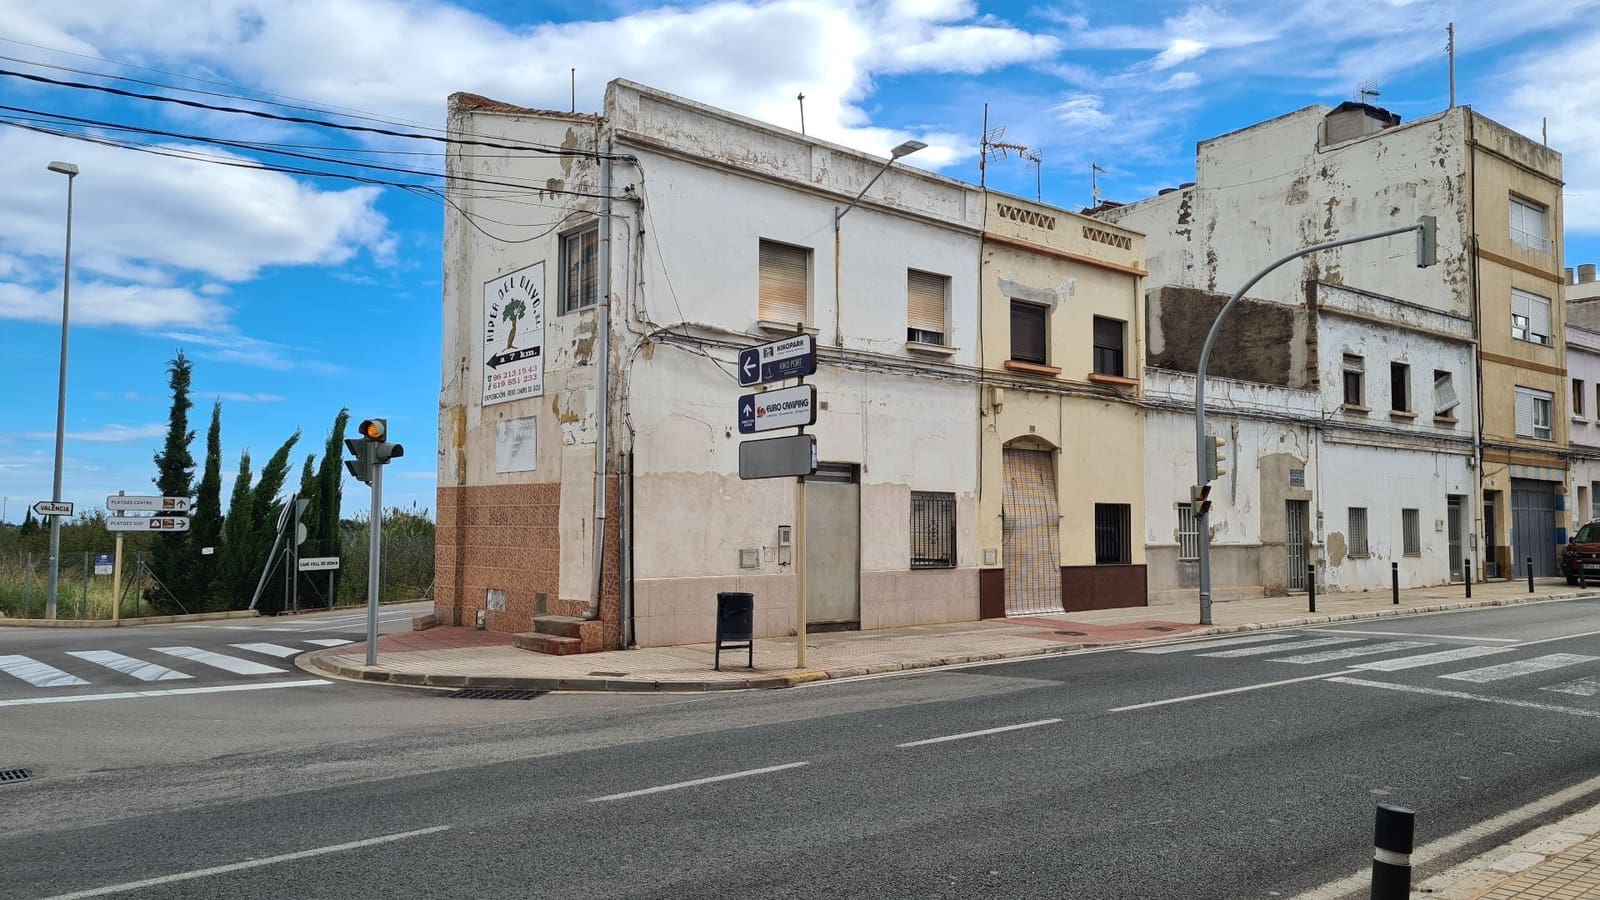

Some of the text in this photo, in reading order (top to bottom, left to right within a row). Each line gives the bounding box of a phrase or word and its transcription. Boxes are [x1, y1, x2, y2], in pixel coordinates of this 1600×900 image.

[498, 277, 515, 300] DEL
[510, 353, 515, 361] 7
[503, 369, 516, 379] 213
[492, 380, 506, 389] 619
[508, 376, 520, 386] 851
[766, 402, 781, 413] EURO
[782, 398, 809, 410] CAMPING
